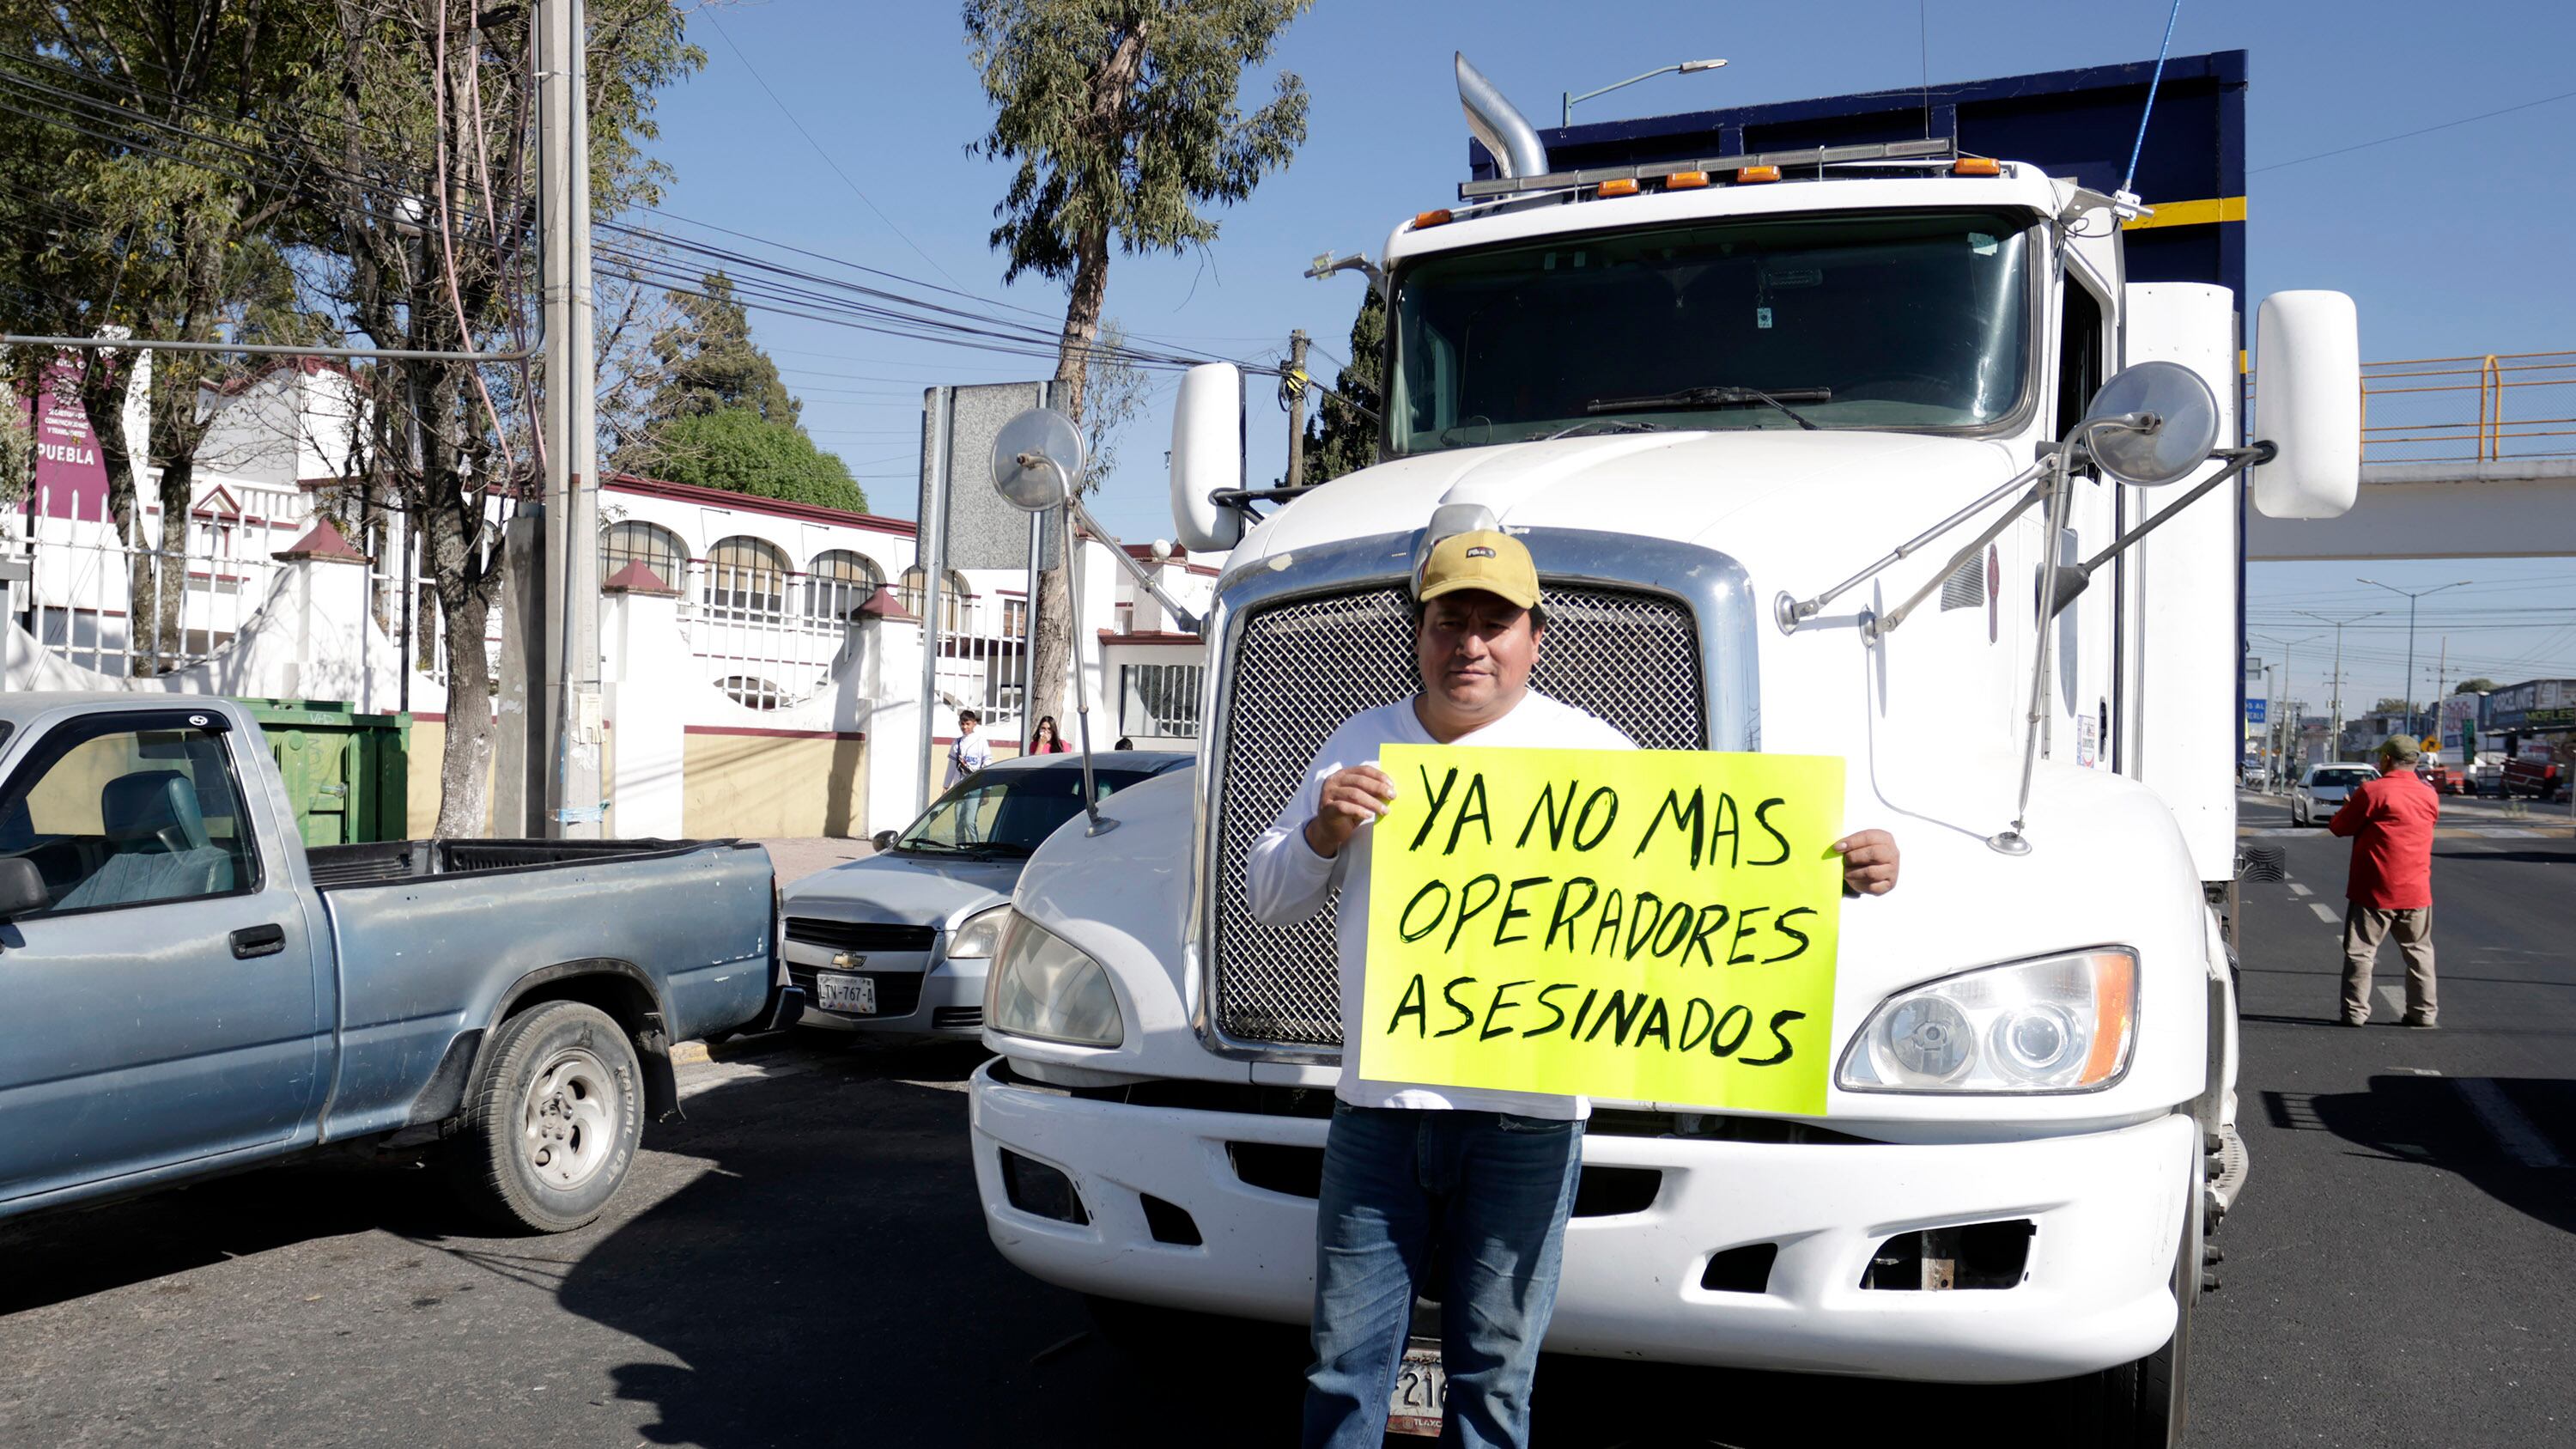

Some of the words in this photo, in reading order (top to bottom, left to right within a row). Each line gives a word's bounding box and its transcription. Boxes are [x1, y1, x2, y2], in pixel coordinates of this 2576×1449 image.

[38, 442, 94, 465] PUEBLA
[1409, 764, 1492, 855] YA
[1516, 780, 1619, 852] NO
[1633, 785, 1790, 871] MAS
[1399, 874, 1818, 967] OPERADORES
[1387, 973, 1806, 1067] ASESINADOS
